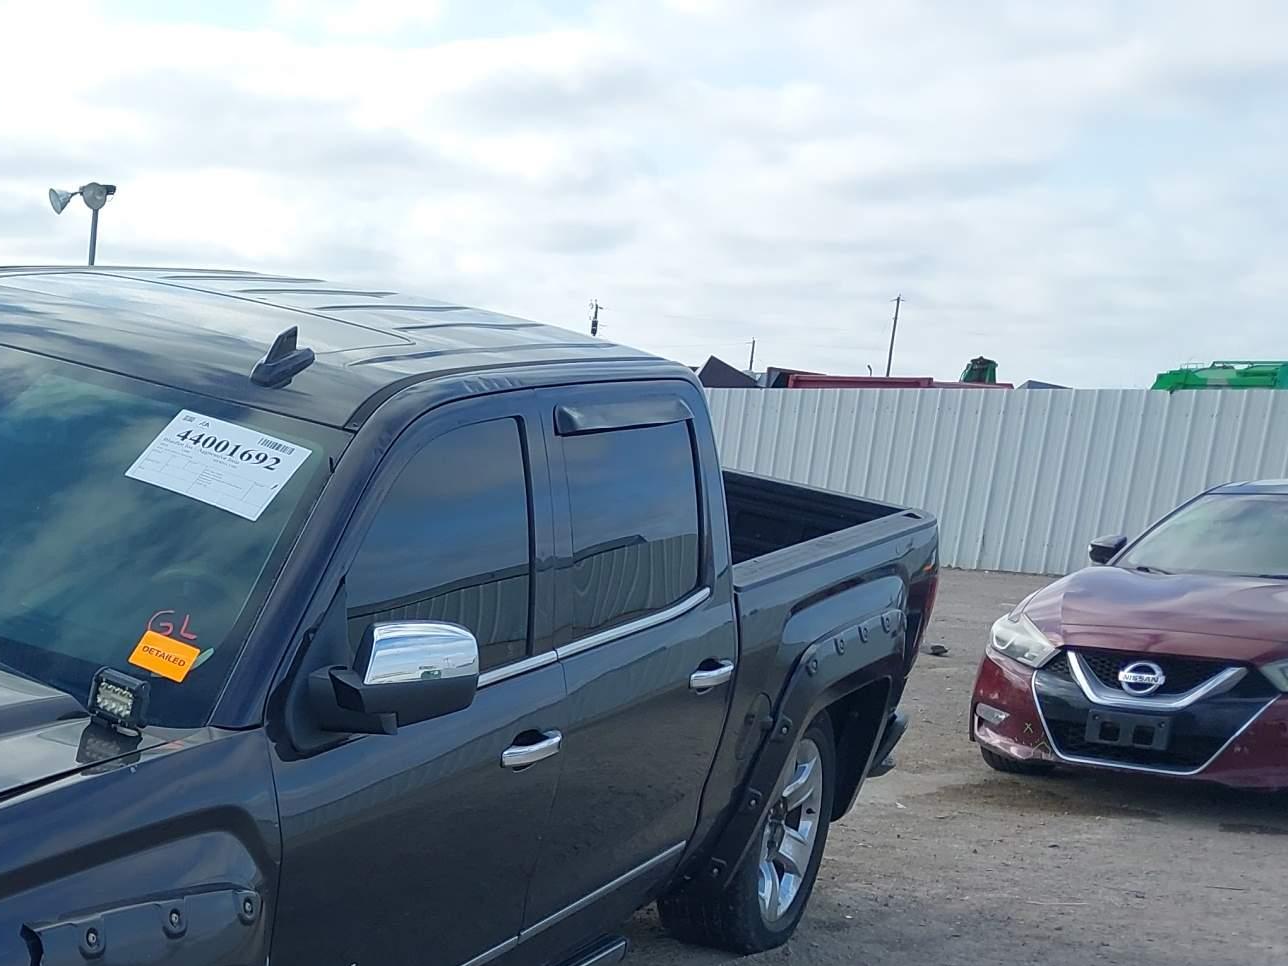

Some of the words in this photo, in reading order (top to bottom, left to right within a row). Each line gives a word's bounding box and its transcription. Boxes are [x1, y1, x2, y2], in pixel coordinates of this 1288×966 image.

[176, 429, 281, 471] 44001692
[142, 646, 186, 667] DETAILED
[1123, 674, 1159, 683] NISSAN
